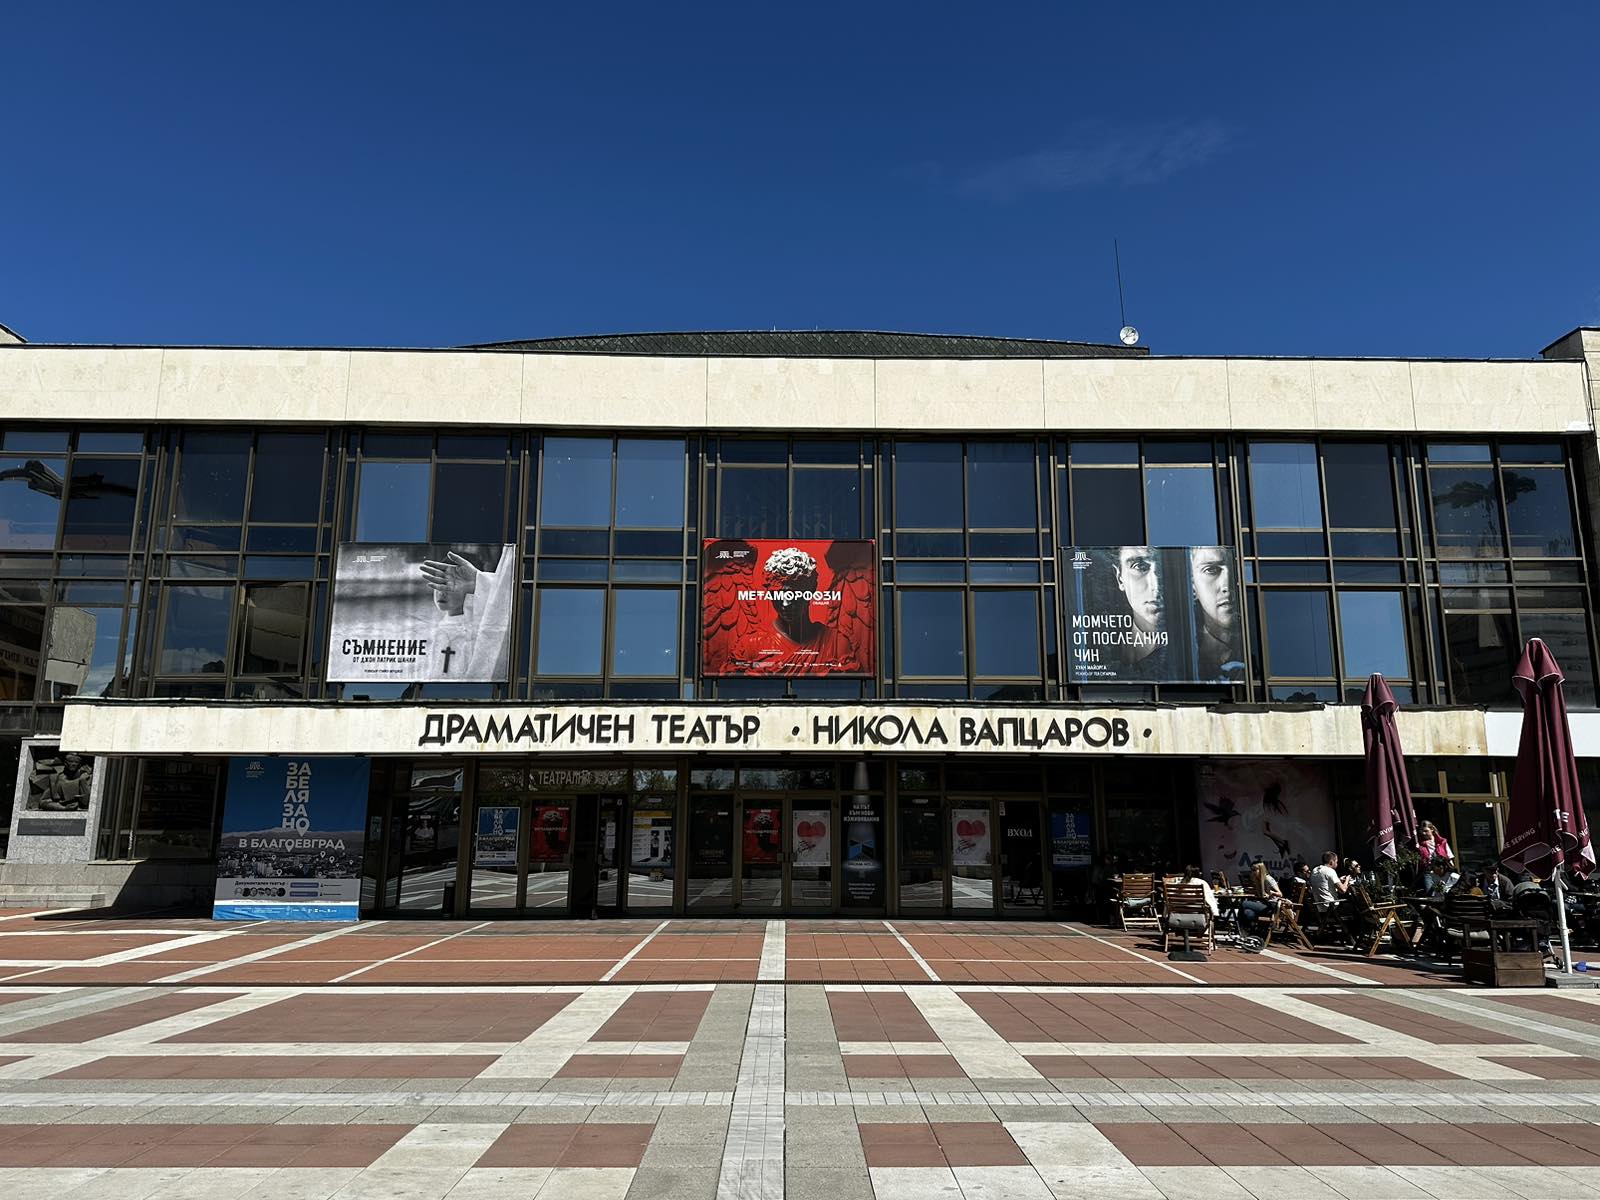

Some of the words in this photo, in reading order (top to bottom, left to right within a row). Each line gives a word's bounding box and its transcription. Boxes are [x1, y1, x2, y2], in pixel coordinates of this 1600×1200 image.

[737, 590, 842, 601] МЕТАМОРФОЗИ
[1072, 615, 1132, 628] МОМЧЕТО
[1073, 631, 1089, 645] ОТ
[1092, 631, 1169, 647] ПОСЛЕДНИЯ
[342, 639, 428, 656] СЪМНЕНИЕ
[1074, 648, 1100, 662] ЧИН
[418, 713, 635, 746] ДРАМАТИЧЕН
[651, 714, 761, 745] ТЕАТЪР
[812, 715, 949, 746] НИКОЛА
[959, 716, 1130, 750] ВАПЦАРОВ
[1007, 828, 1033, 838] ВХОД
[239, 838, 248, 848] В
[250, 838, 345, 852] БЛАГОЕВГРАД
